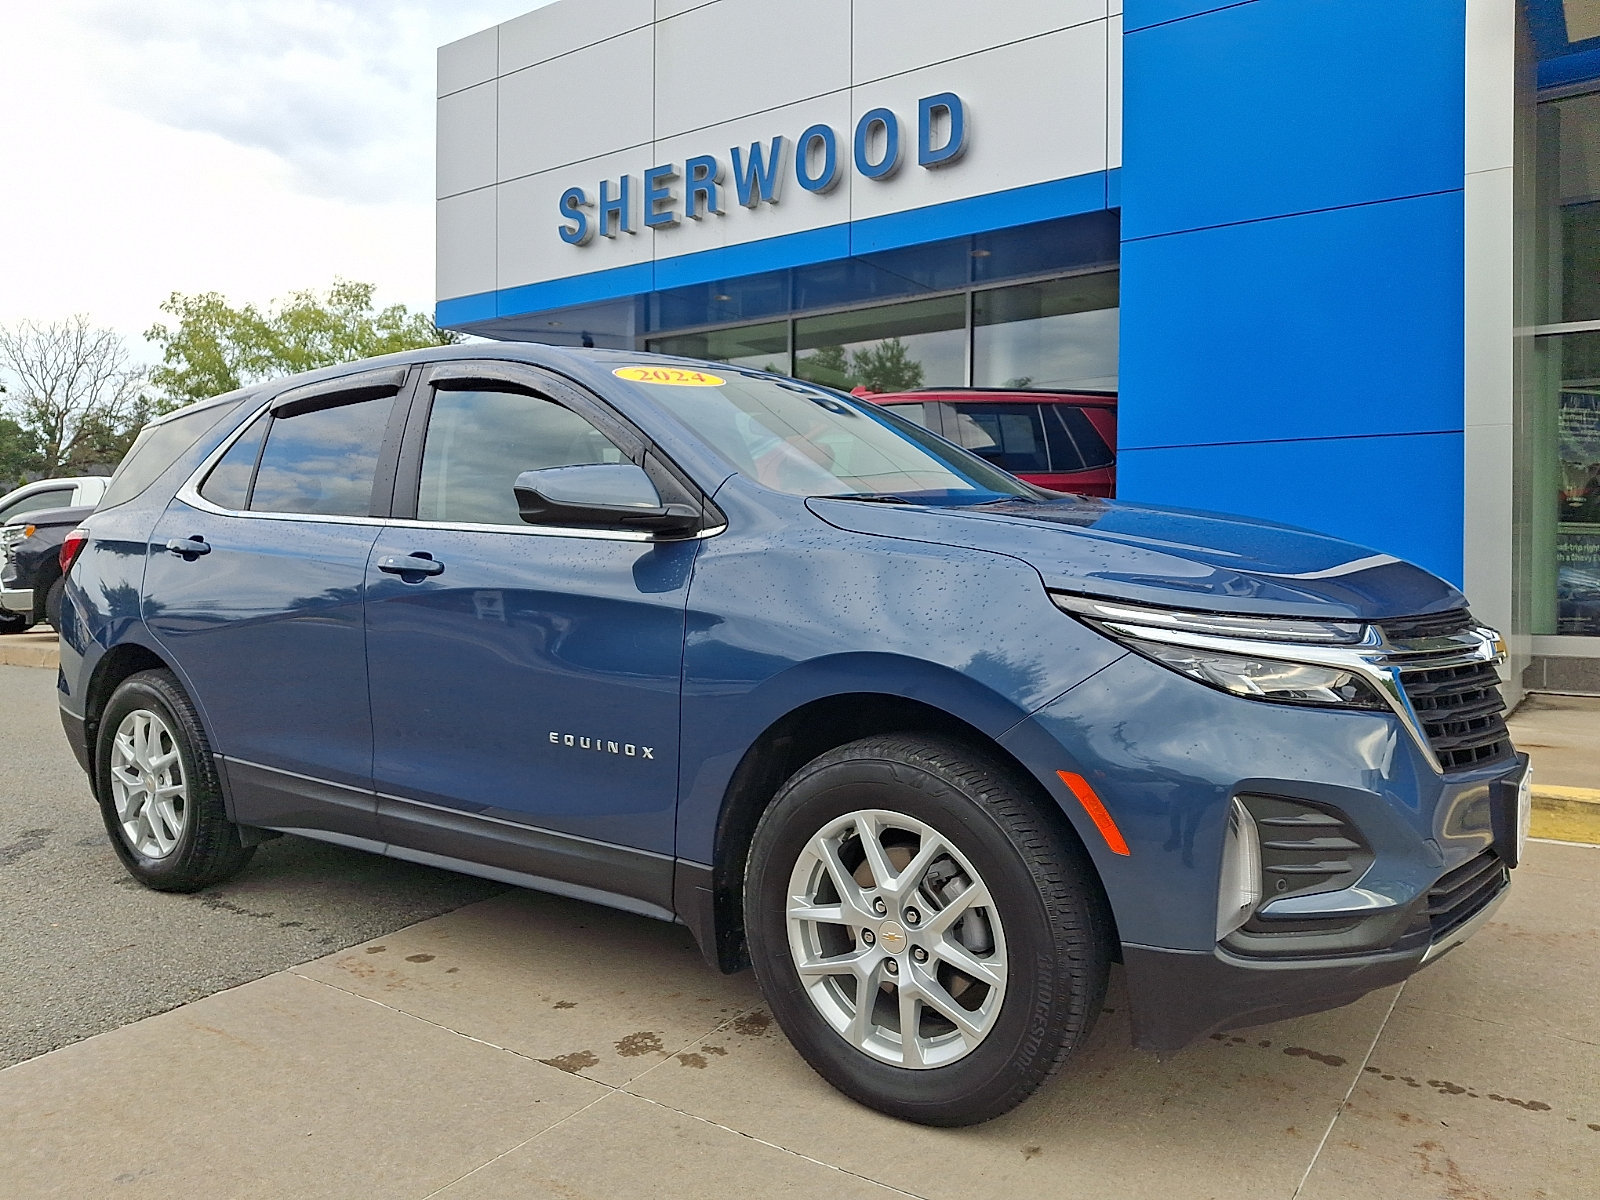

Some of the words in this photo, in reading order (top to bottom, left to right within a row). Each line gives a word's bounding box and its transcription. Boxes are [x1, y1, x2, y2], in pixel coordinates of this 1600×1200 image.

[558, 92, 971, 246] SHERWOOD
[634, 369, 705, 382] 2024
[549, 731, 654, 760] EQUINOX
[1012, 951, 1055, 1075] BRIDGESTONE
